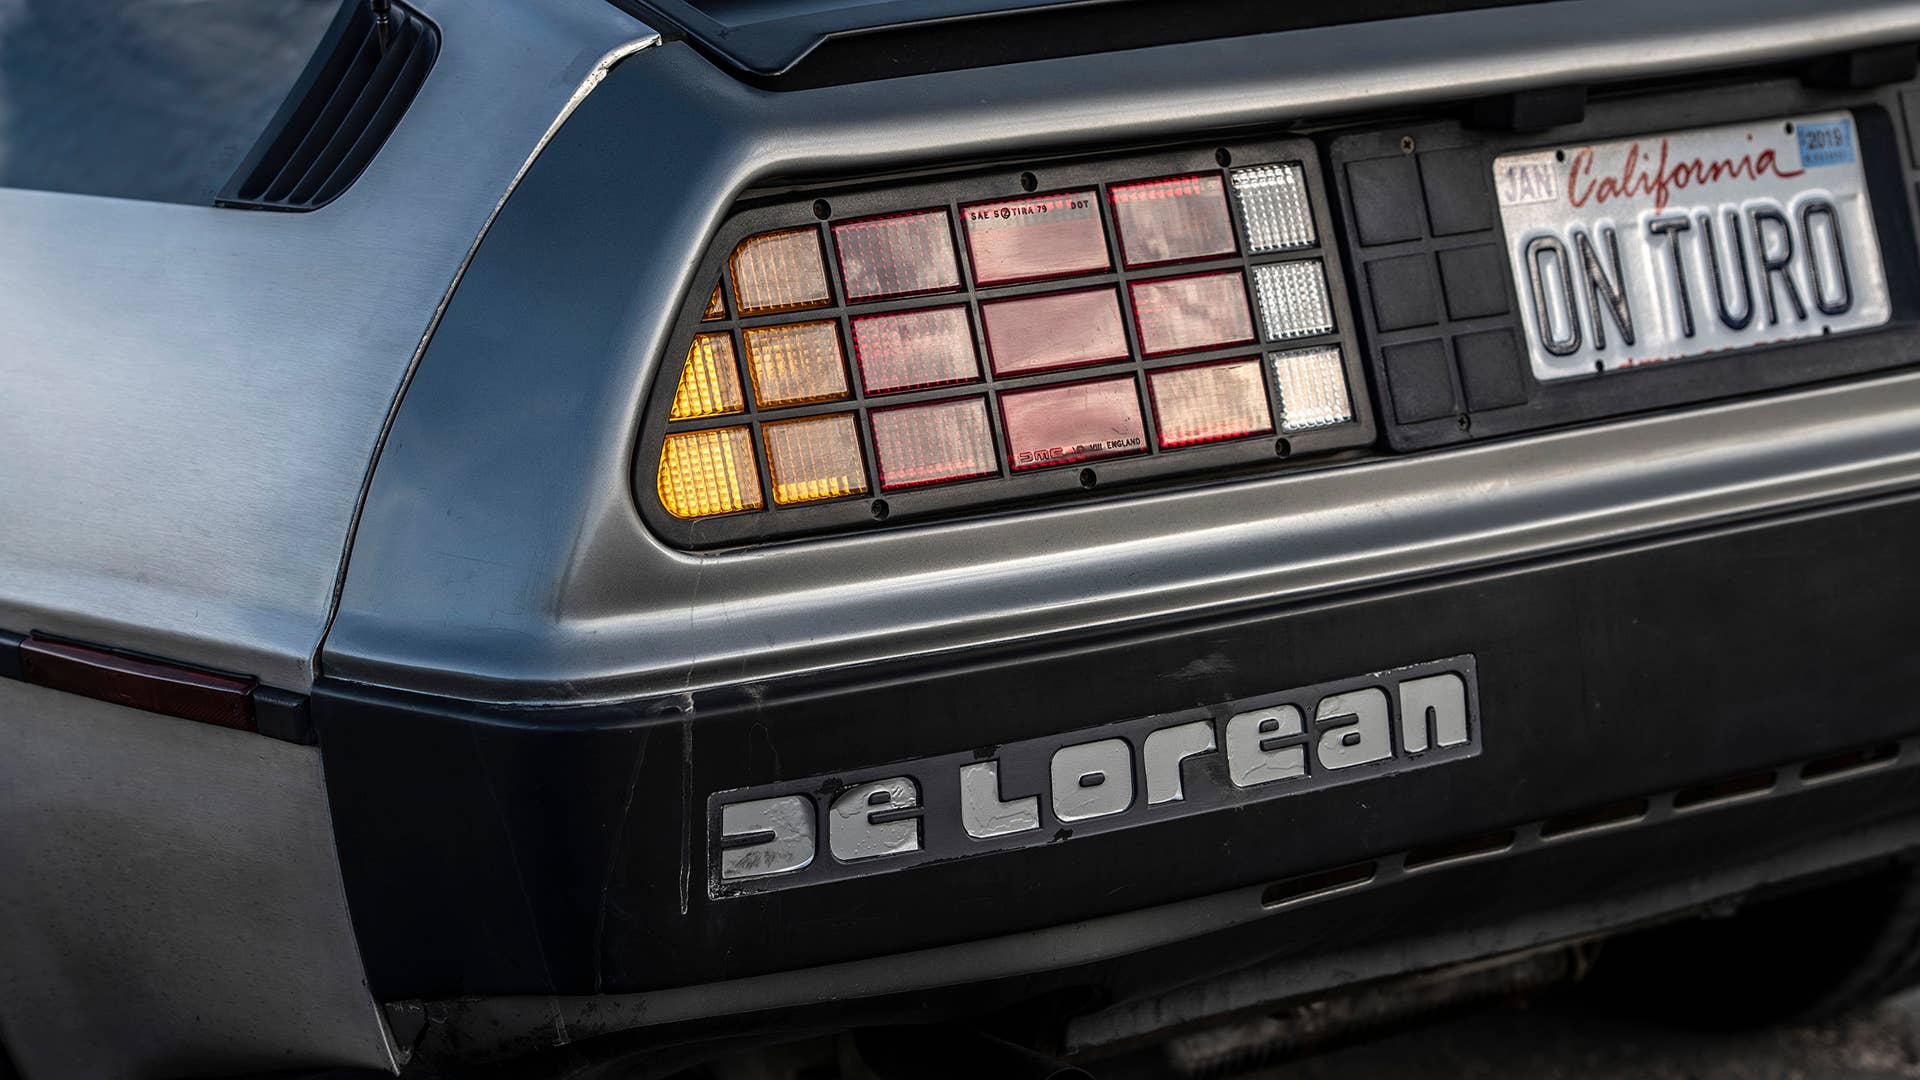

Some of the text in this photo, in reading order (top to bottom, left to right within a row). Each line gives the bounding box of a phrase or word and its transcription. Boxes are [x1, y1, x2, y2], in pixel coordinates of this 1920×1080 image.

[1808, 127, 1843, 150] 2019
[1504, 163, 1553, 203] JAN
[1567, 134, 1805, 215] California
[970, 210, 989, 220] SAE
[1036, 204, 1048, 213] 79
[1071, 200, 1089, 210] DOT
[1525, 199, 1852, 356] ON TURO
[1106, 437, 1141, 449] ENGLAND
